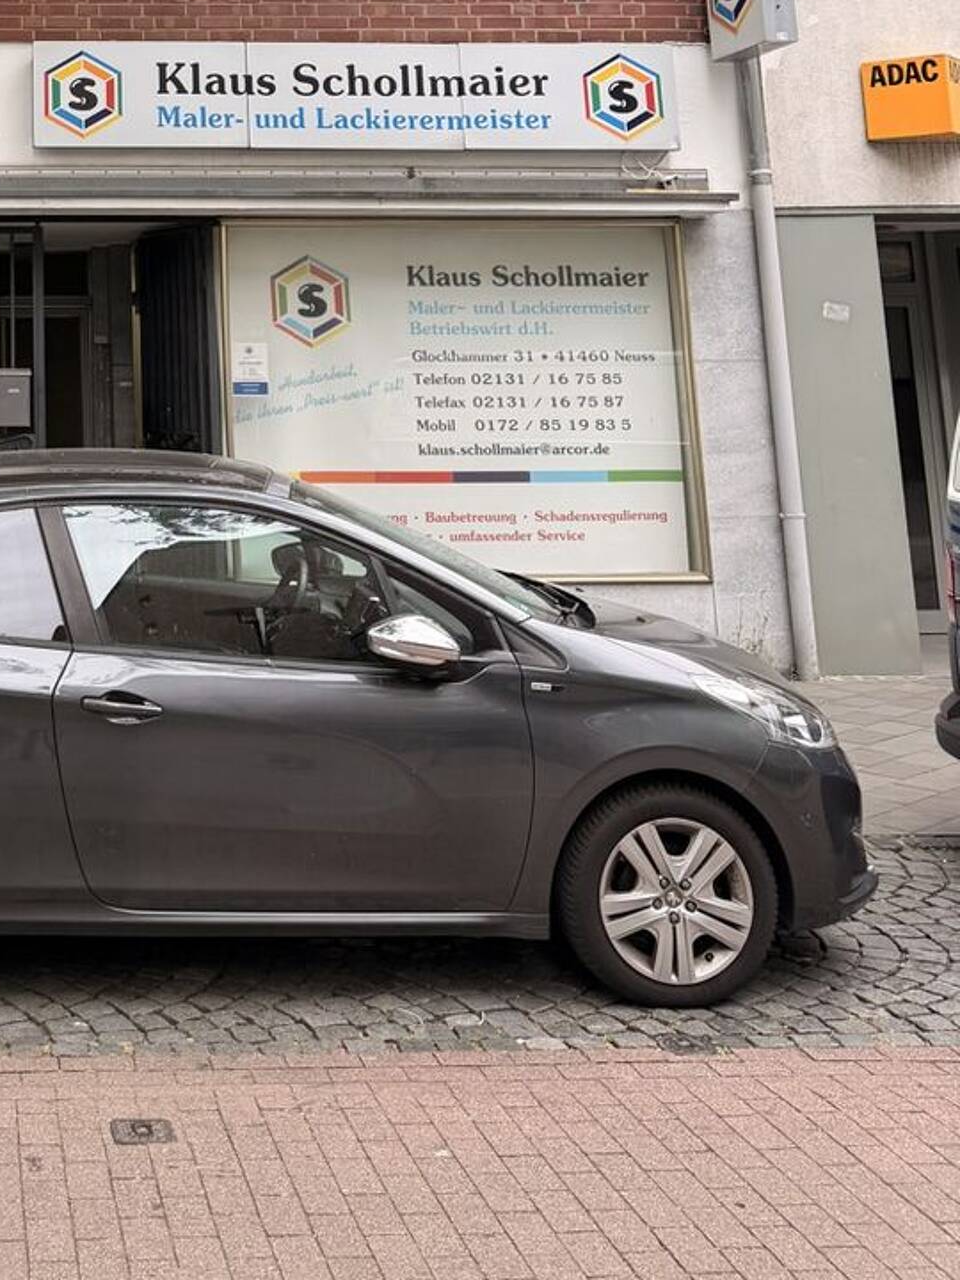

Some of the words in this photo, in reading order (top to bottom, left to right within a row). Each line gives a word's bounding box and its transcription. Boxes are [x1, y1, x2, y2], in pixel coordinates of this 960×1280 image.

[156, 62, 276, 96] Klaus
[293, 63, 548, 97] Schollmaier
[870, 59, 938, 87] ADAC
[68, 78, 98, 110] S
[608, 80, 639, 113] S
[156, 106, 243, 128] Maler-
[255, 106, 305, 129] und
[316, 106, 551, 130] Lackierermeister
[406, 266, 481, 288] Klaus
[491, 265, 649, 288] Schollmaier
[298, 282, 327, 318] S
[408, 300, 465, 315] Maler-
[473, 300, 504, 315] und
[511, 300, 651, 315] Lackierermeister
[410, 321, 511, 336] Betriebswirt
[518, 321, 553, 336] d.H.
[411, 350, 508, 363] Glockhammer
[513, 350, 533, 362] 31
[554, 350, 609, 362] 41460
[614, 349, 656, 362] Neuss
[413, 373, 466, 385] Telefon
[470, 373, 524, 385] 02131
[549, 373, 569, 385] 16
[575, 373, 596, 385] 75
[602, 373, 622, 385] 85
[415, 396, 466, 408] Telefax
[472, 396, 526, 408] 02131
[551, 396, 571, 408] 16
[577, 396, 598, 408] 75
[604, 396, 624, 408] 87
[416, 419, 456, 432] Mobil
[474, 419, 519, 431] 0172
[540, 419, 561, 431] 85
[570, 419, 589, 431] 19
[595, 419, 616, 431] 83
[622, 419, 632, 431] 5
[418, 443, 611, 456] klaus.schollmaier@arcor.de
[425, 511, 517, 525] Baubetreuung
[534, 510, 668, 525] Schadensregulierung
[449, 530, 532, 543] umfassender
[537, 530, 585, 542] Service
